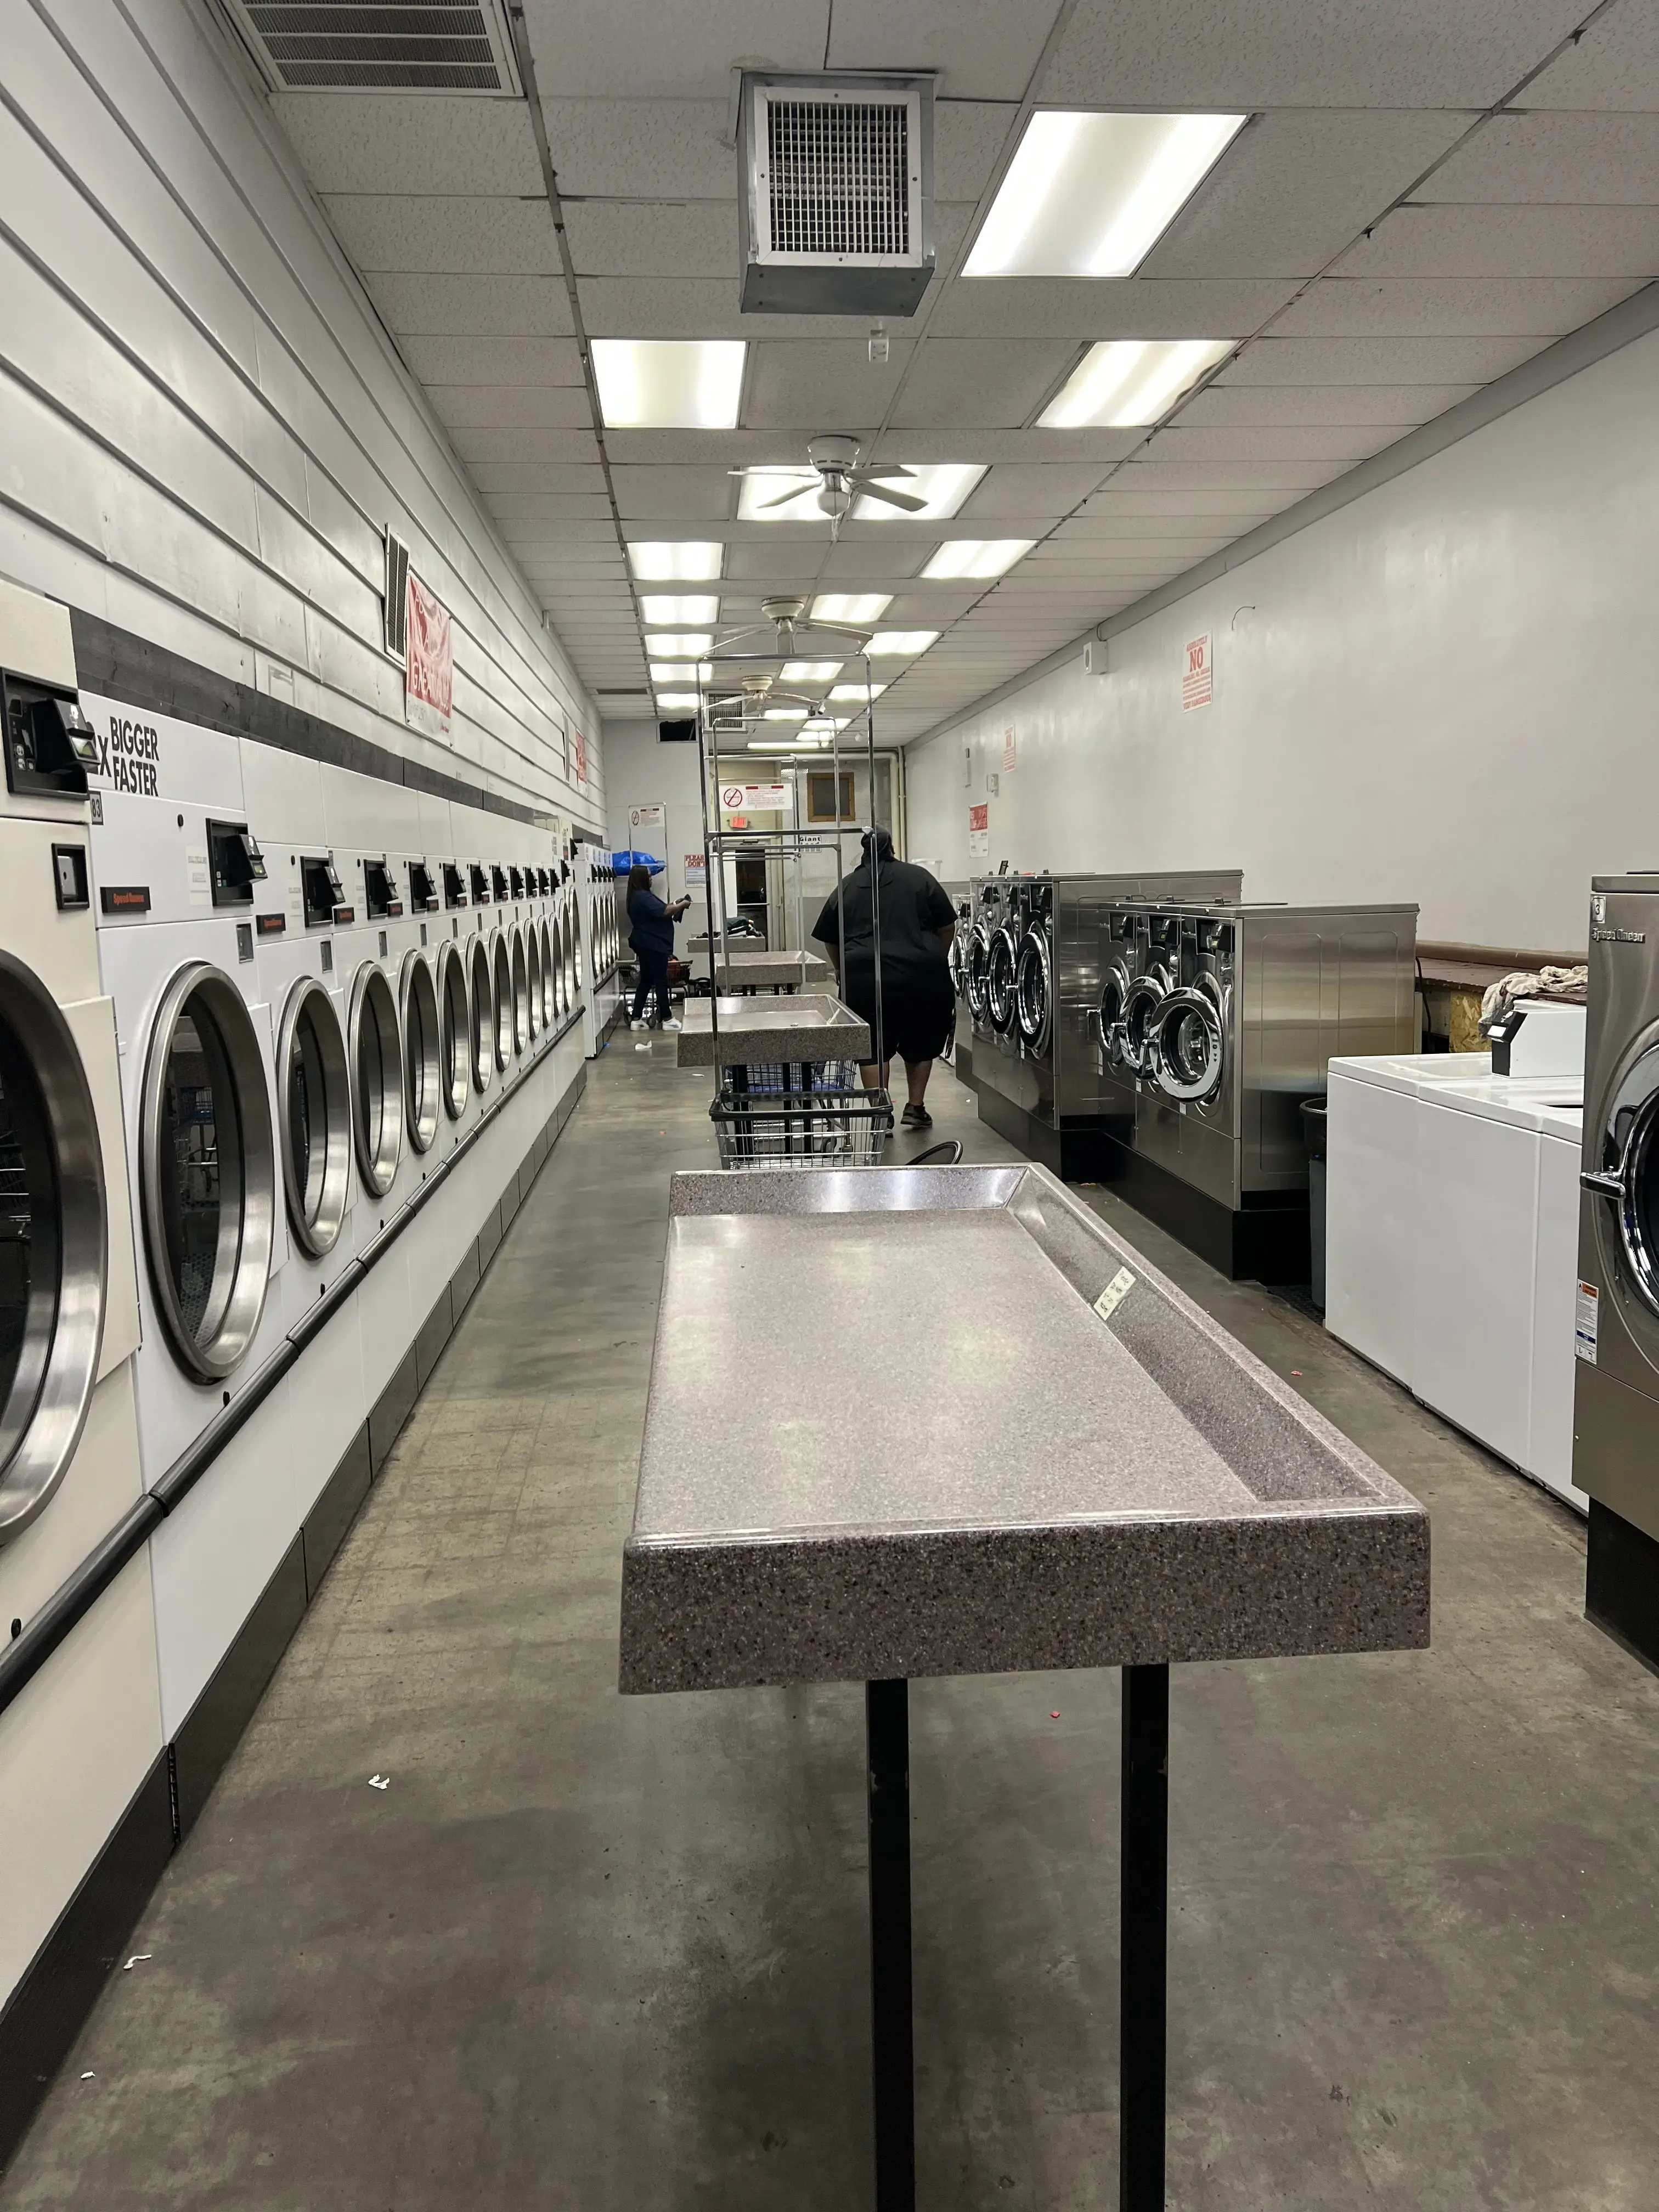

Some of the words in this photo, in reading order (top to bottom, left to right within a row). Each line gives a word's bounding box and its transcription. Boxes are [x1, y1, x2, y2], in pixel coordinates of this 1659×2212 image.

[1190, 647, 1203, 672] NO
[110, 716, 160, 761] BIGGER
[112, 755, 159, 797] FASTER
[92, 798, 101, 817] 83
[1595, 904, 1600, 915] 3
[1591, 927, 1616, 943] Speed
[1616, 928, 1646, 943] Queen
